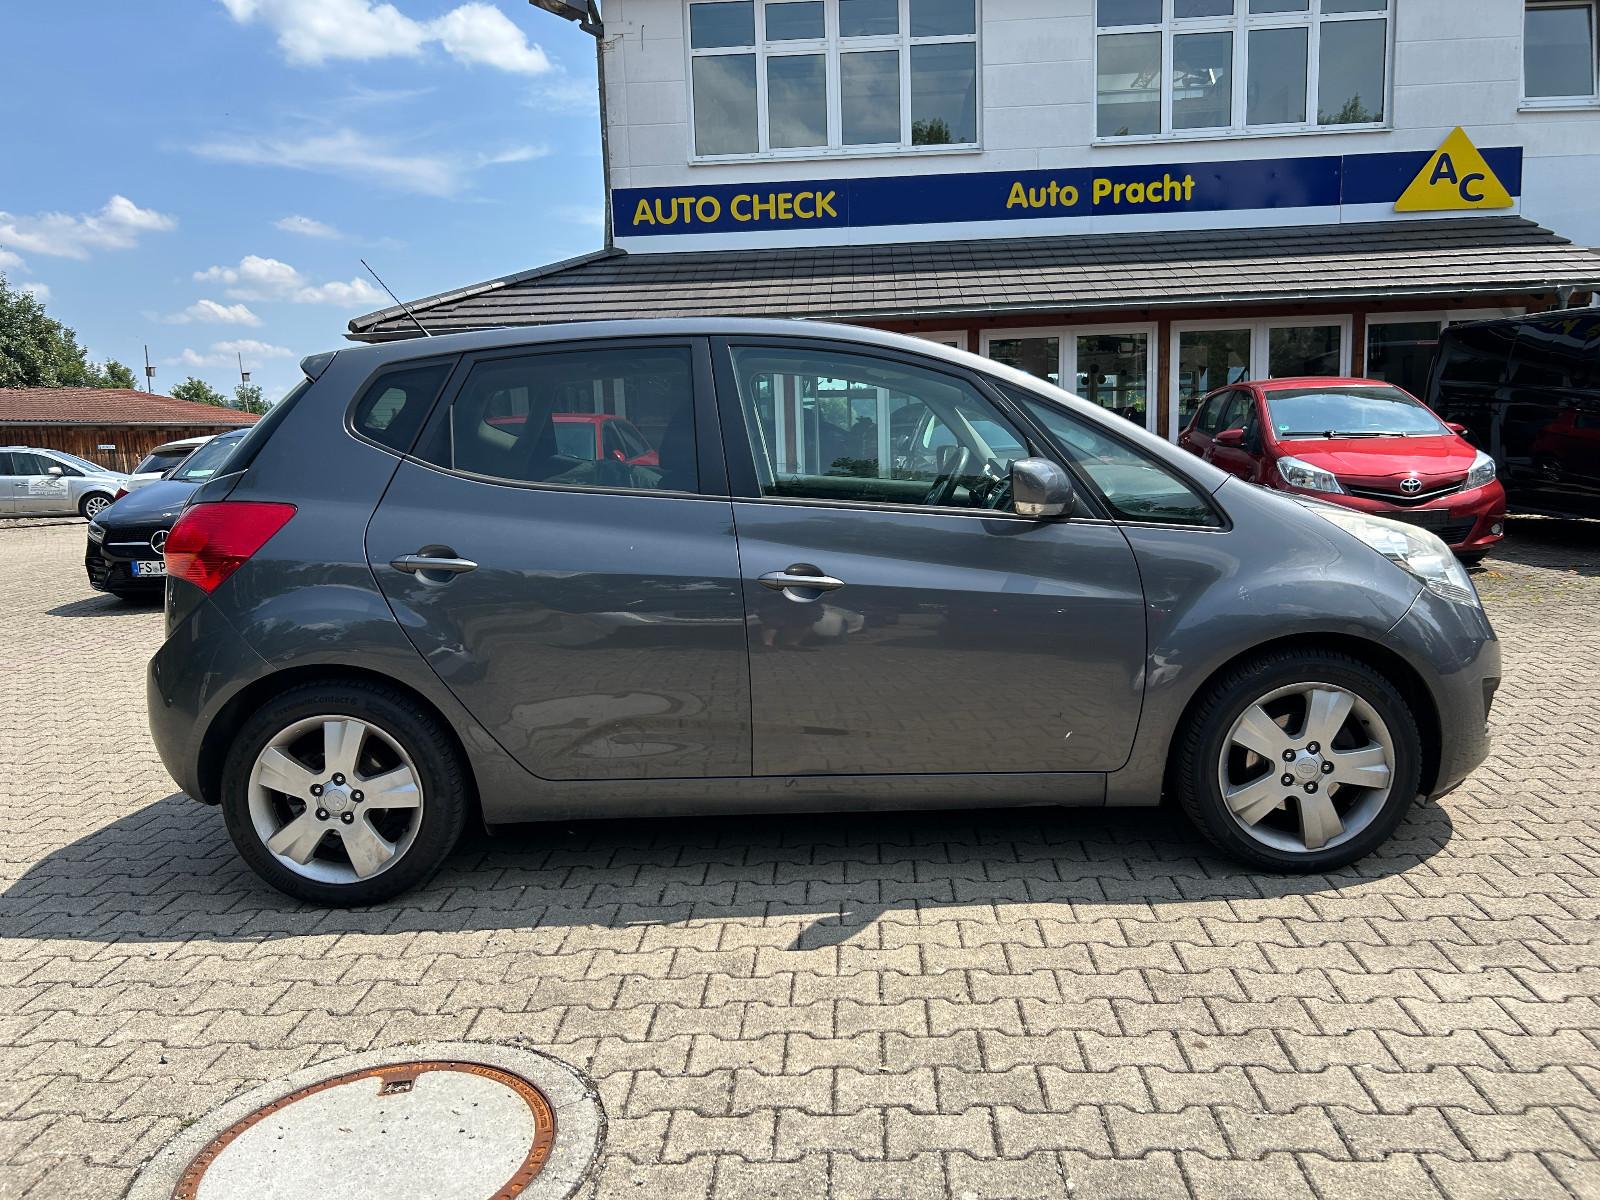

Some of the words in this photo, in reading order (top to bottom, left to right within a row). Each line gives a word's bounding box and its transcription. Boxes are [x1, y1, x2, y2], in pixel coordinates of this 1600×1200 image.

[632, 196, 721, 225] AUTO
[730, 190, 838, 222] CHECK
[1006, 180, 1079, 208] Auto
[1093, 173, 1196, 205] Pracht
[138, 562, 152, 574] FS
